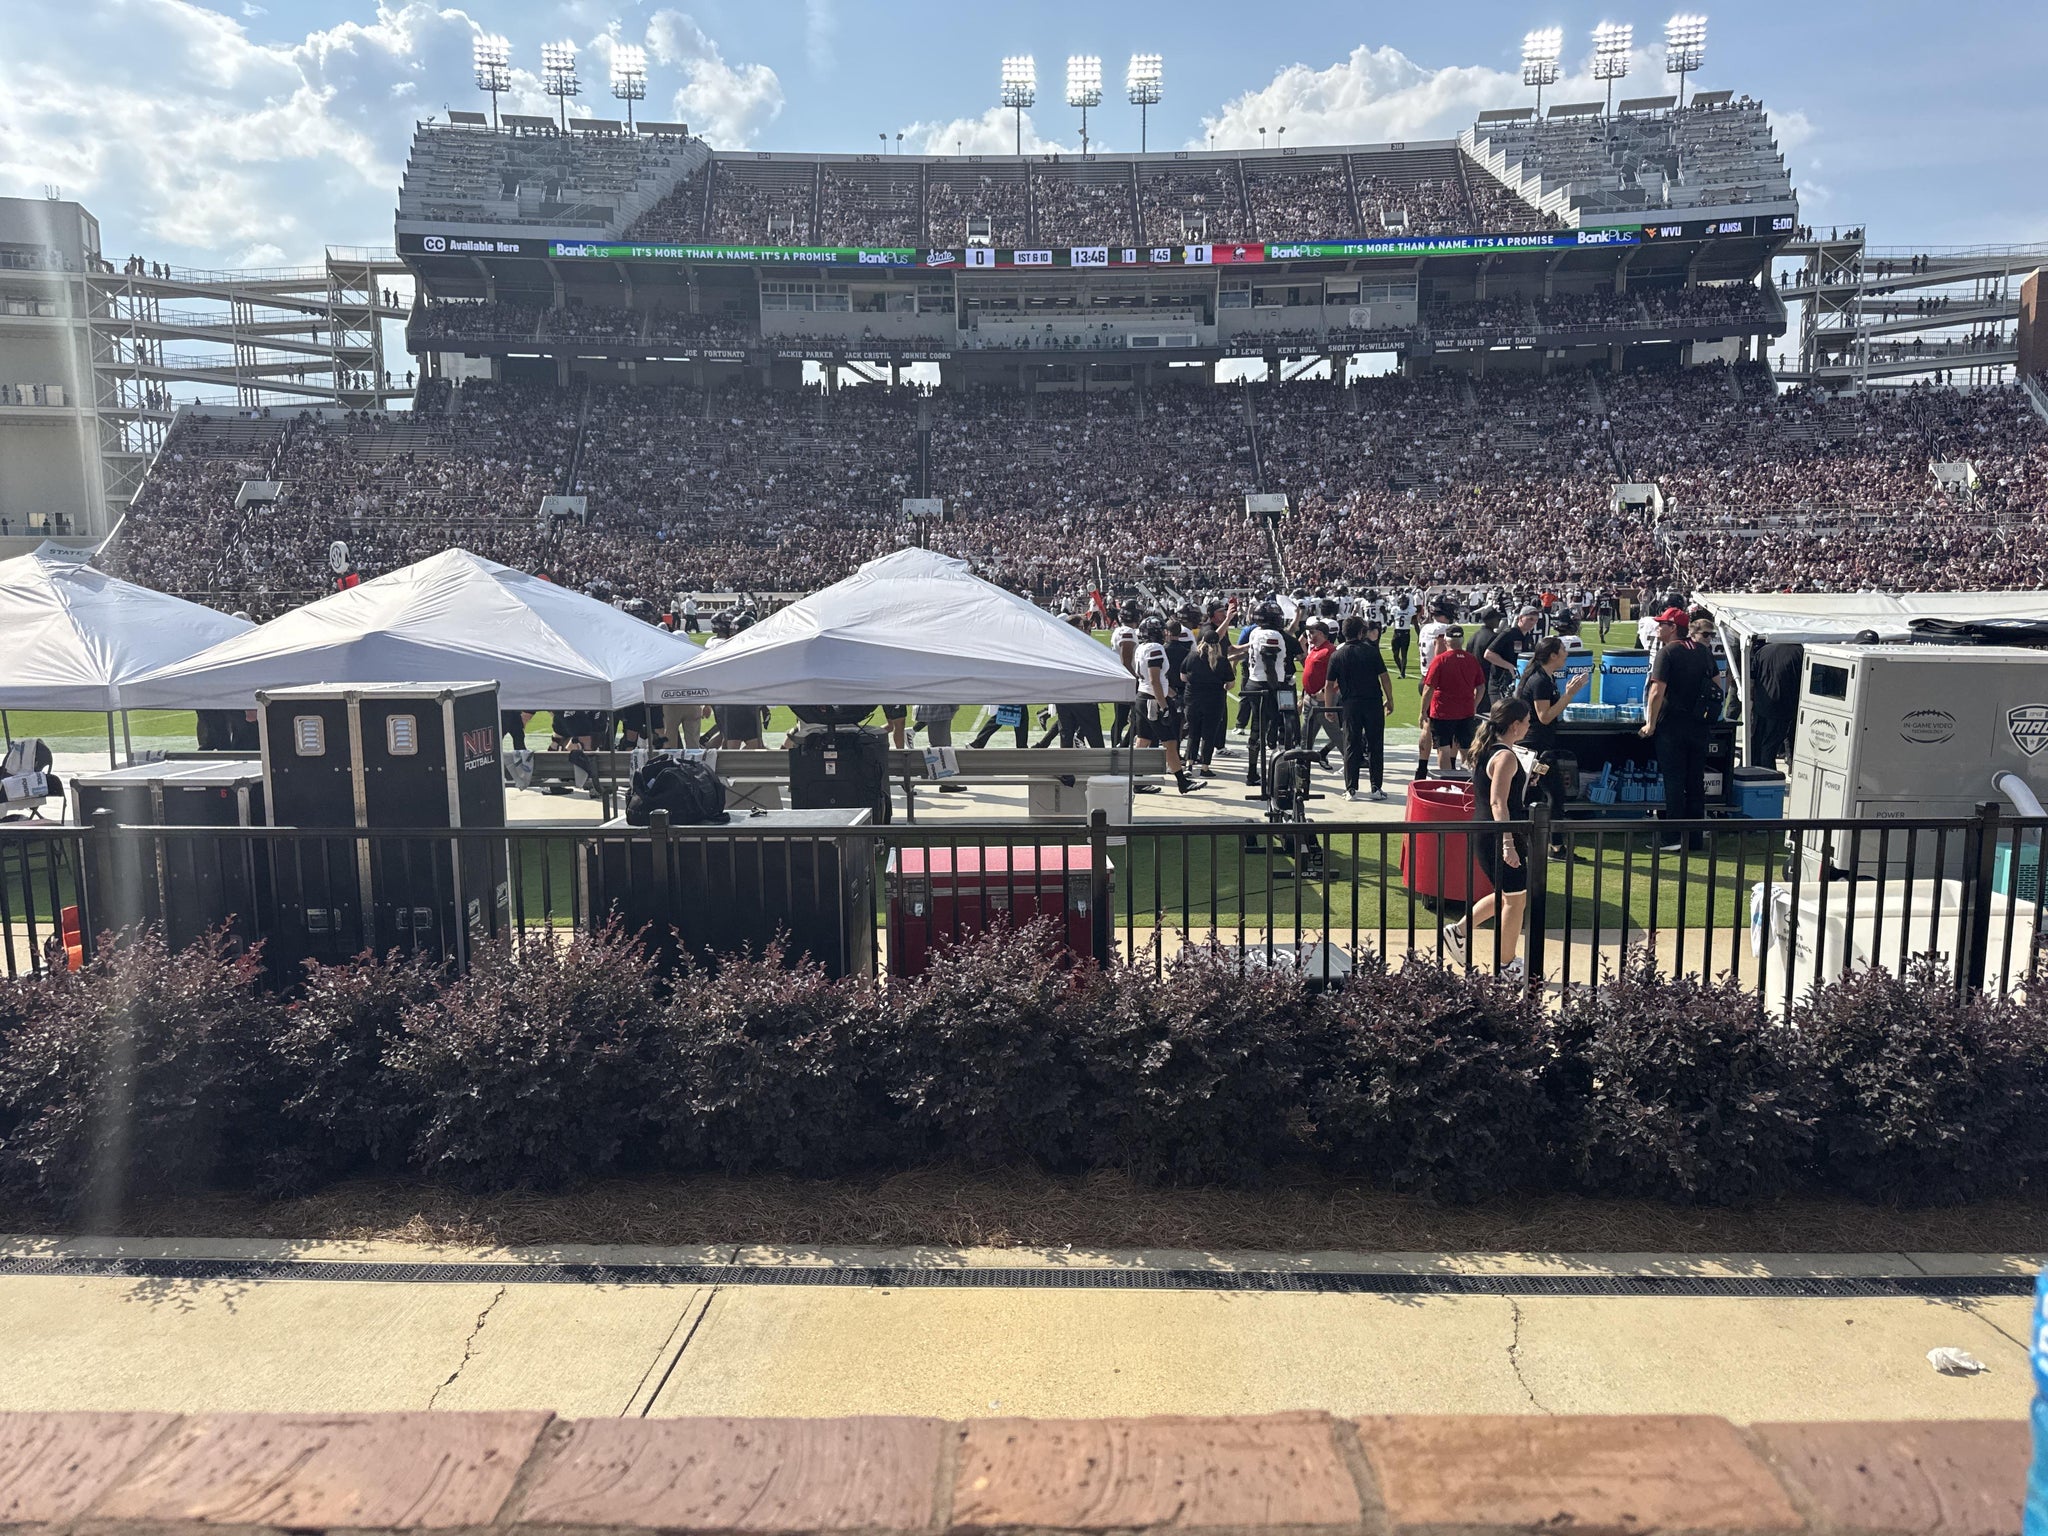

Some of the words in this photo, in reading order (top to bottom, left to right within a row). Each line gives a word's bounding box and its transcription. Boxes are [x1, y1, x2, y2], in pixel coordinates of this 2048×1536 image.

[1719, 222, 1742, 233] KANSA
[1772, 218, 1793, 230] 5:00
[1577, 229, 1632, 244] BankPlus
[1660, 226, 1682, 237] WVU
[426, 239, 445, 249] CC
[450, 240, 494, 252] Available
[497, 241, 519, 252] Here
[1344, 245, 1363, 253] IT'S
[1366, 243, 1395, 252] MORE
[1398, 241, 1425, 251] THAN
[1428, 241, 1435, 250] A
[1438, 239, 1471, 250] NAME.
[1474, 238, 1494, 248] IT'S
[1497, 238, 1504, 247] A
[1507, 235, 1554, 247] PROMISE
[556, 243, 609, 258] BankPlus
[632, 247, 652, 257] IT'S
[655, 248, 683, 258] MORE
[686, 249, 714, 259] THAN
[717, 250, 724, 259] A
[726, 250, 758, 260] NAME.
[762, 251, 780, 260] IT'S
[783, 252, 790, 261] A
[793, 252, 837, 261] PROMISE
[1075, 250, 1105, 263] 13:46
[1156, 251, 1168, 260] 45
[1195, 248, 1203, 261] 0
[1271, 246, 1322, 259] BankPlus
[859, 251, 908, 264] BankPlus
[927, 248, 955, 266] State
[976, 251, 984, 265] 0
[1018, 253, 1030, 262] 1ST
[1033, 253, 1038, 262] &
[1040, 253, 1048, 262] 10
[1327, 344, 1355, 352] SHORTY
[1359, 342, 1405, 351] McWILLIAMS
[704, 350, 745, 358] FORTUNATO
[806, 351, 833, 359] PARKER
[864, 352, 891, 360] CRISTIL
[1600, 600, 1610, 609] 21
[1399, 615, 1405, 627] 6
[462, 726, 494, 760] NIU
[464, 755, 495, 771] FOOTBALL
[1797, 772, 1808, 780] DATA
[1825, 781, 1840, 791] POWER
